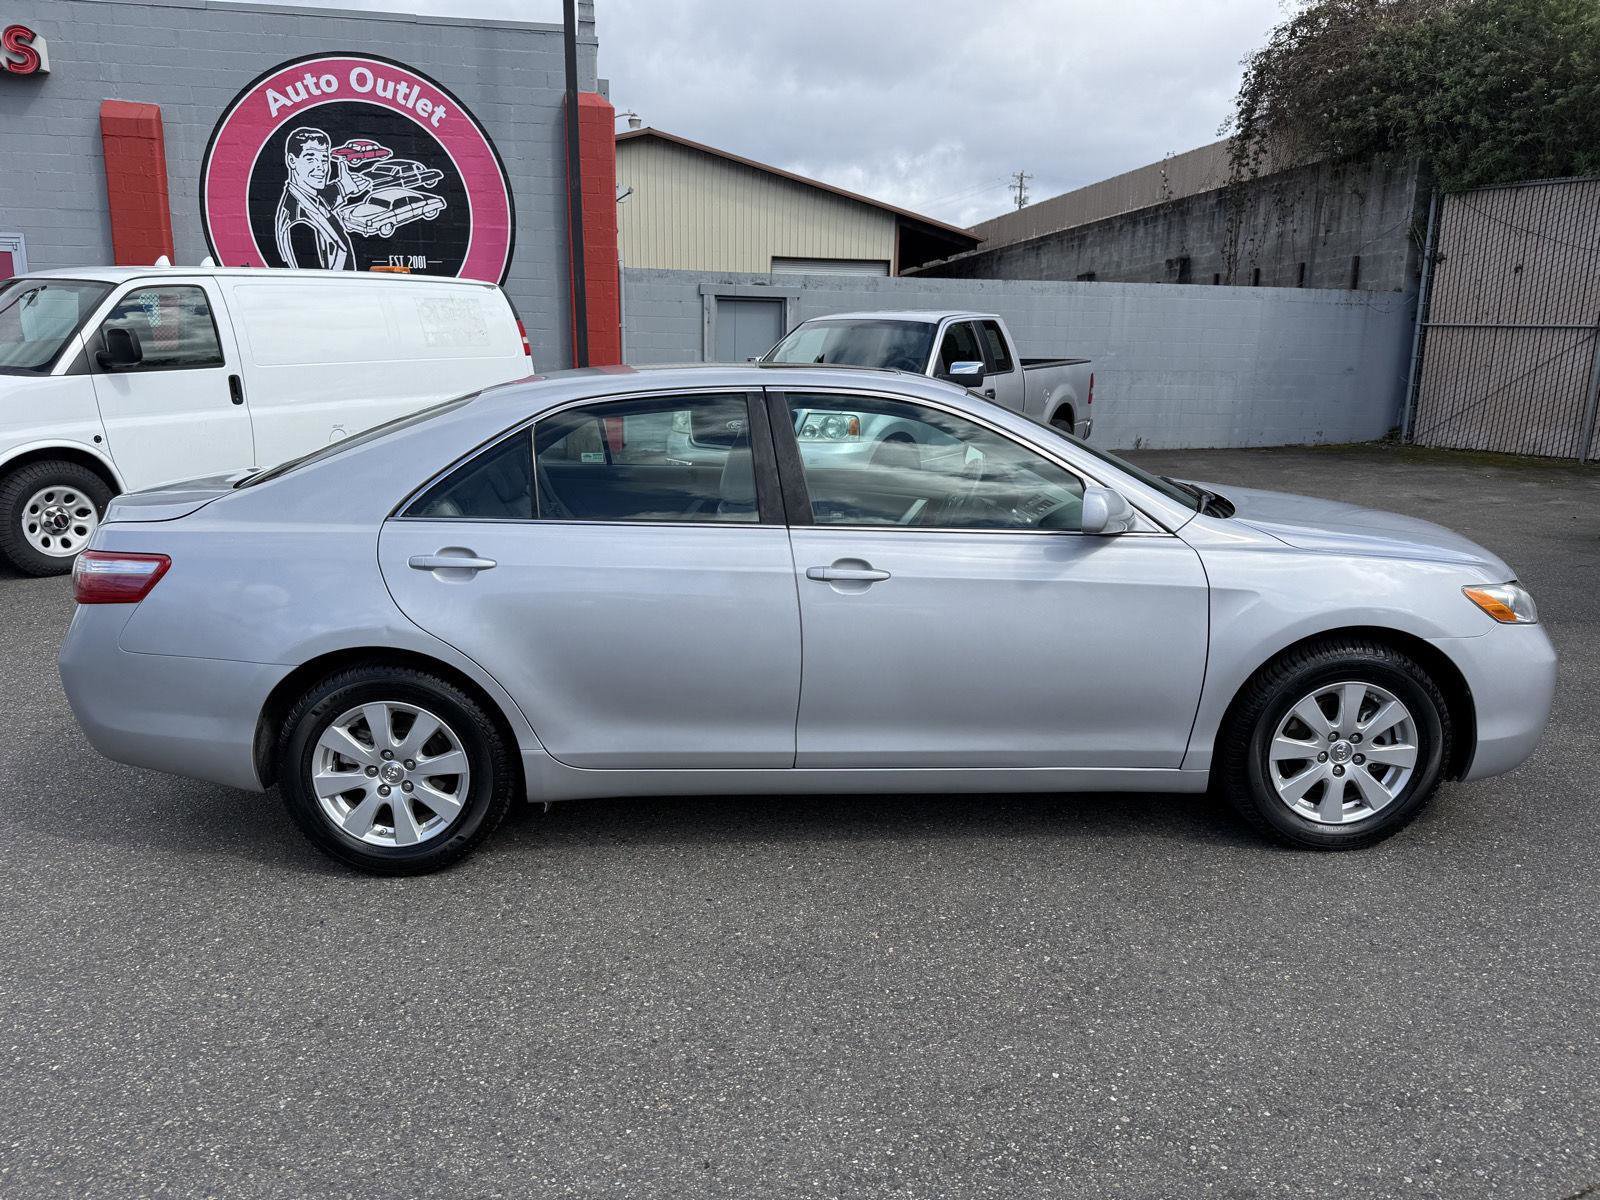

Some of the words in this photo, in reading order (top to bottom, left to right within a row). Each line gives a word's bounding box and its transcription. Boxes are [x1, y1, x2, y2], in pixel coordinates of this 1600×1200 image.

[0, 24, 42, 75] S
[265, 73, 339, 118] Auto
[350, 67, 446, 128] Outlet
[389, 255, 404, 267] EST
[408, 255, 427, 269] 2001
